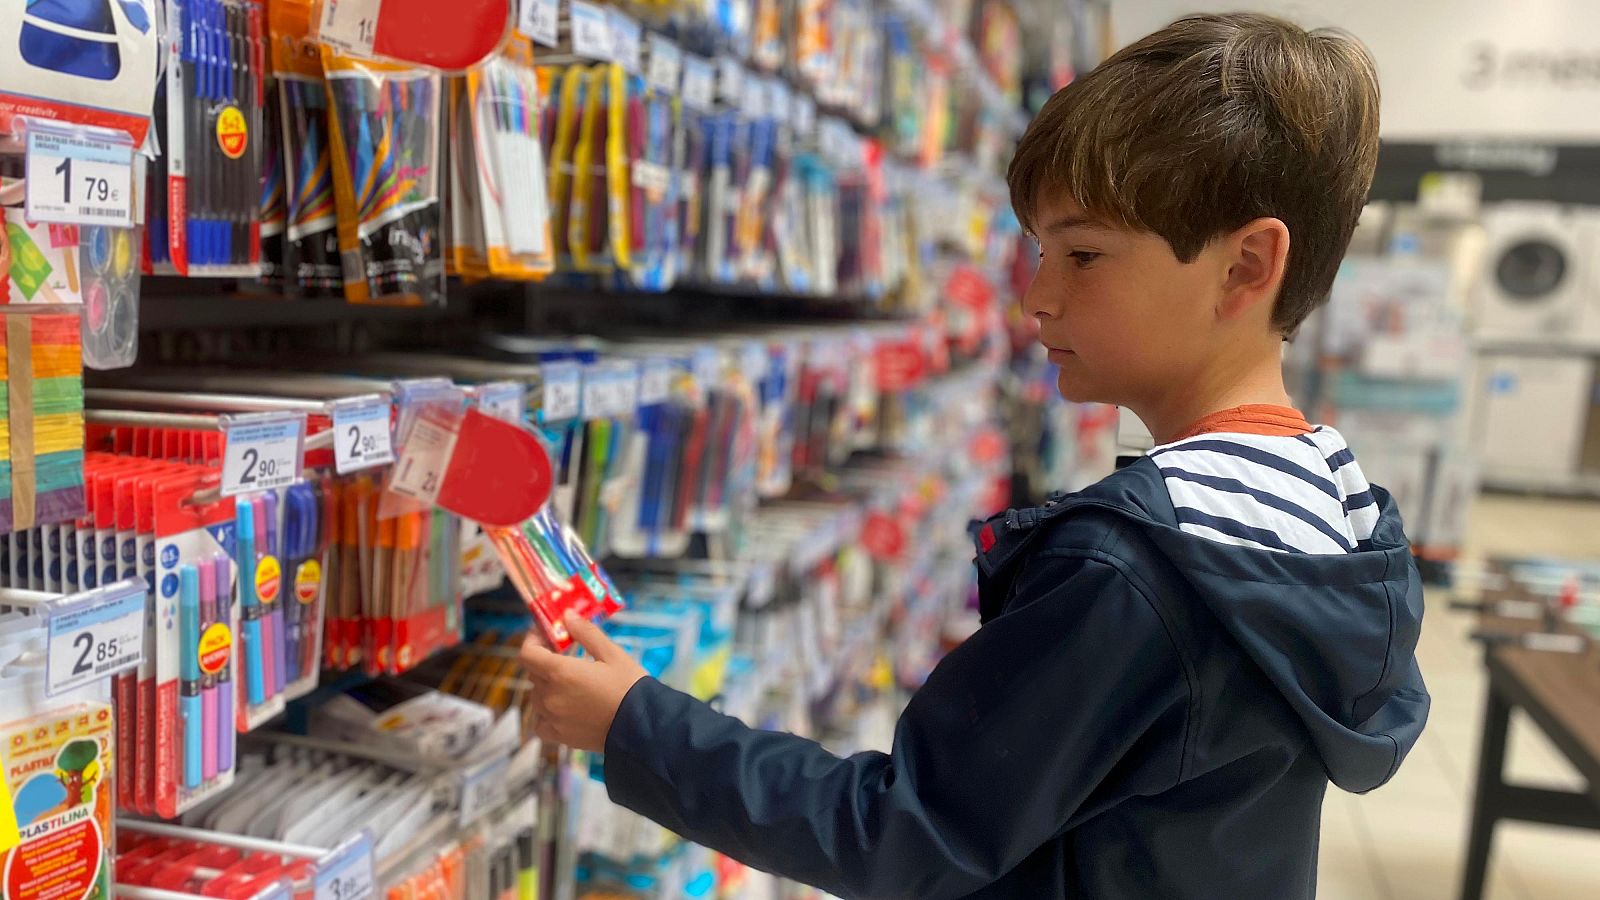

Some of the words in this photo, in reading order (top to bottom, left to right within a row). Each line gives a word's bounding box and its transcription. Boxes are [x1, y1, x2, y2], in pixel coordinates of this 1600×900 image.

[16, 104, 58, 118] creativity
[55, 157, 71, 203] 1
[85, 177, 109, 202] 79
[348, 425, 362, 458] 2
[362, 435, 376, 452] 90
[240, 448, 259, 484] 2
[259, 459, 275, 477] 90
[72, 631, 94, 675] 2
[96, 638, 118, 662] 85
[20, 807, 89, 839] PLASTILINA
